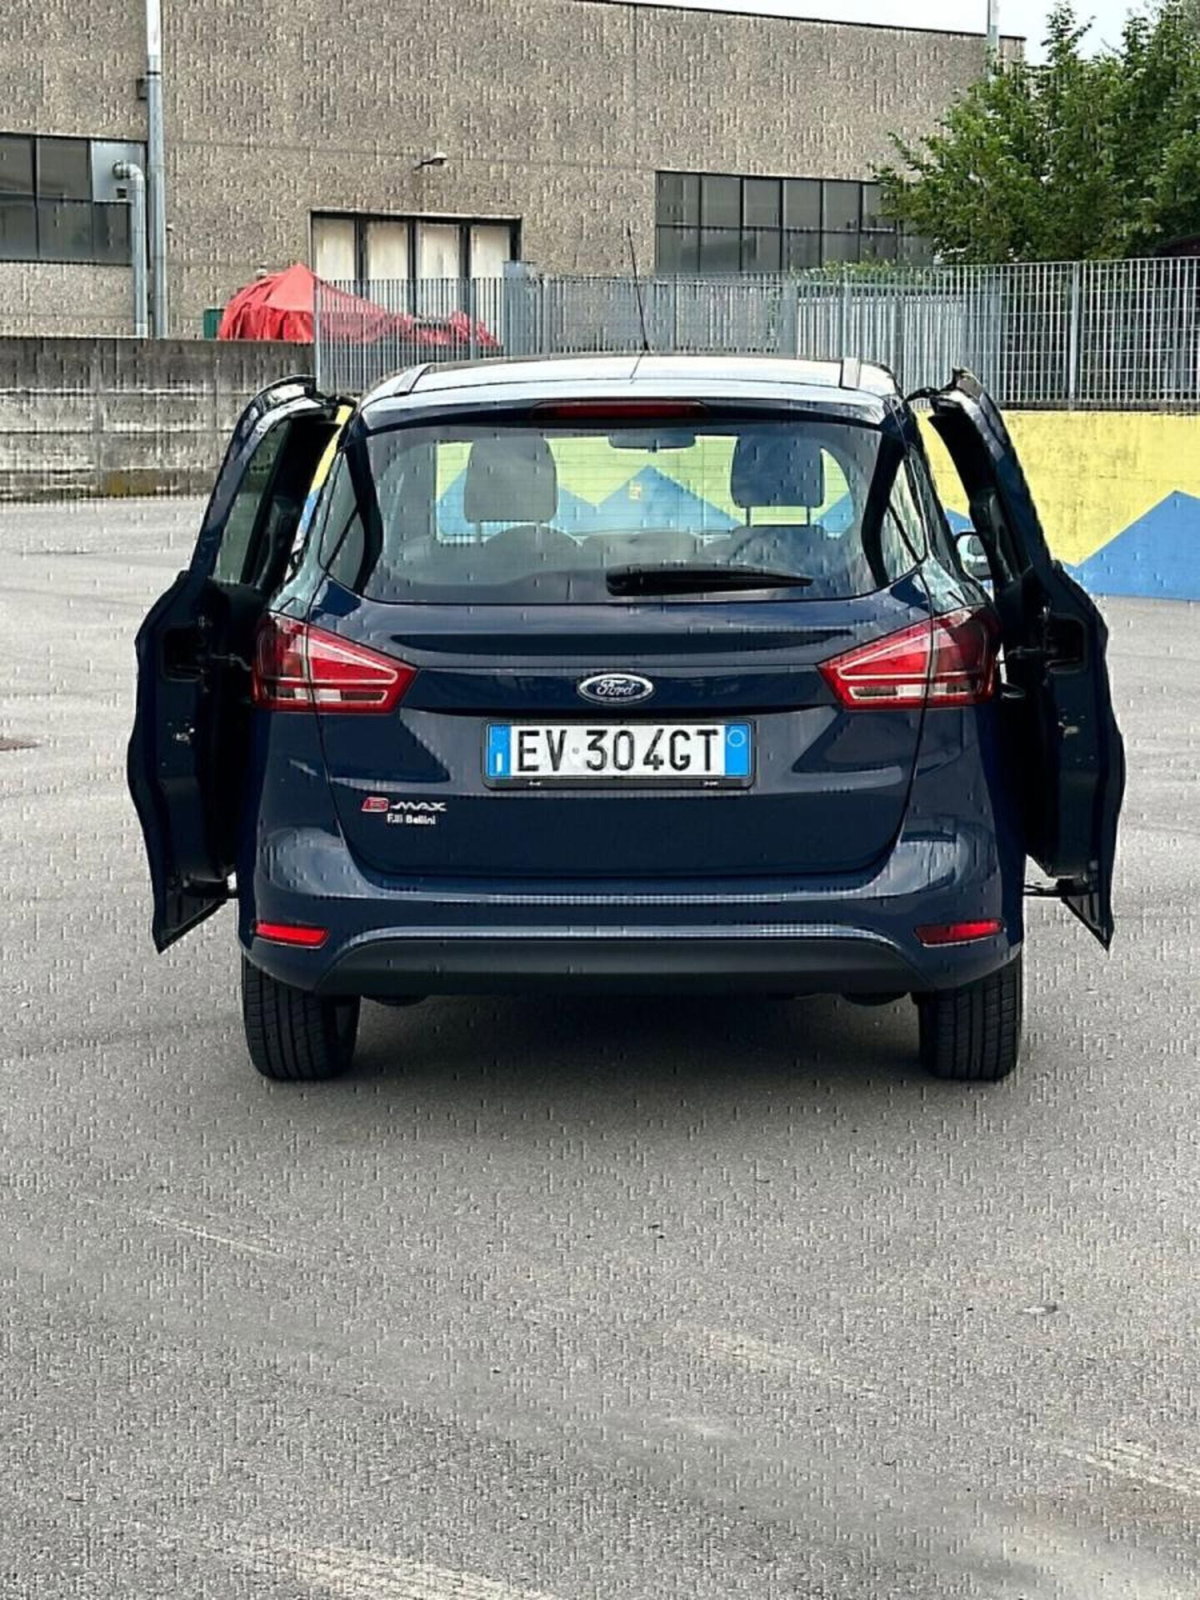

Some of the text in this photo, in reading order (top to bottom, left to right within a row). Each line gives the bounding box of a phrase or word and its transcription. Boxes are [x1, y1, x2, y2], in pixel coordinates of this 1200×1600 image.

[596, 678, 639, 696] Ford
[517, 729, 718, 771] EV 304GT
